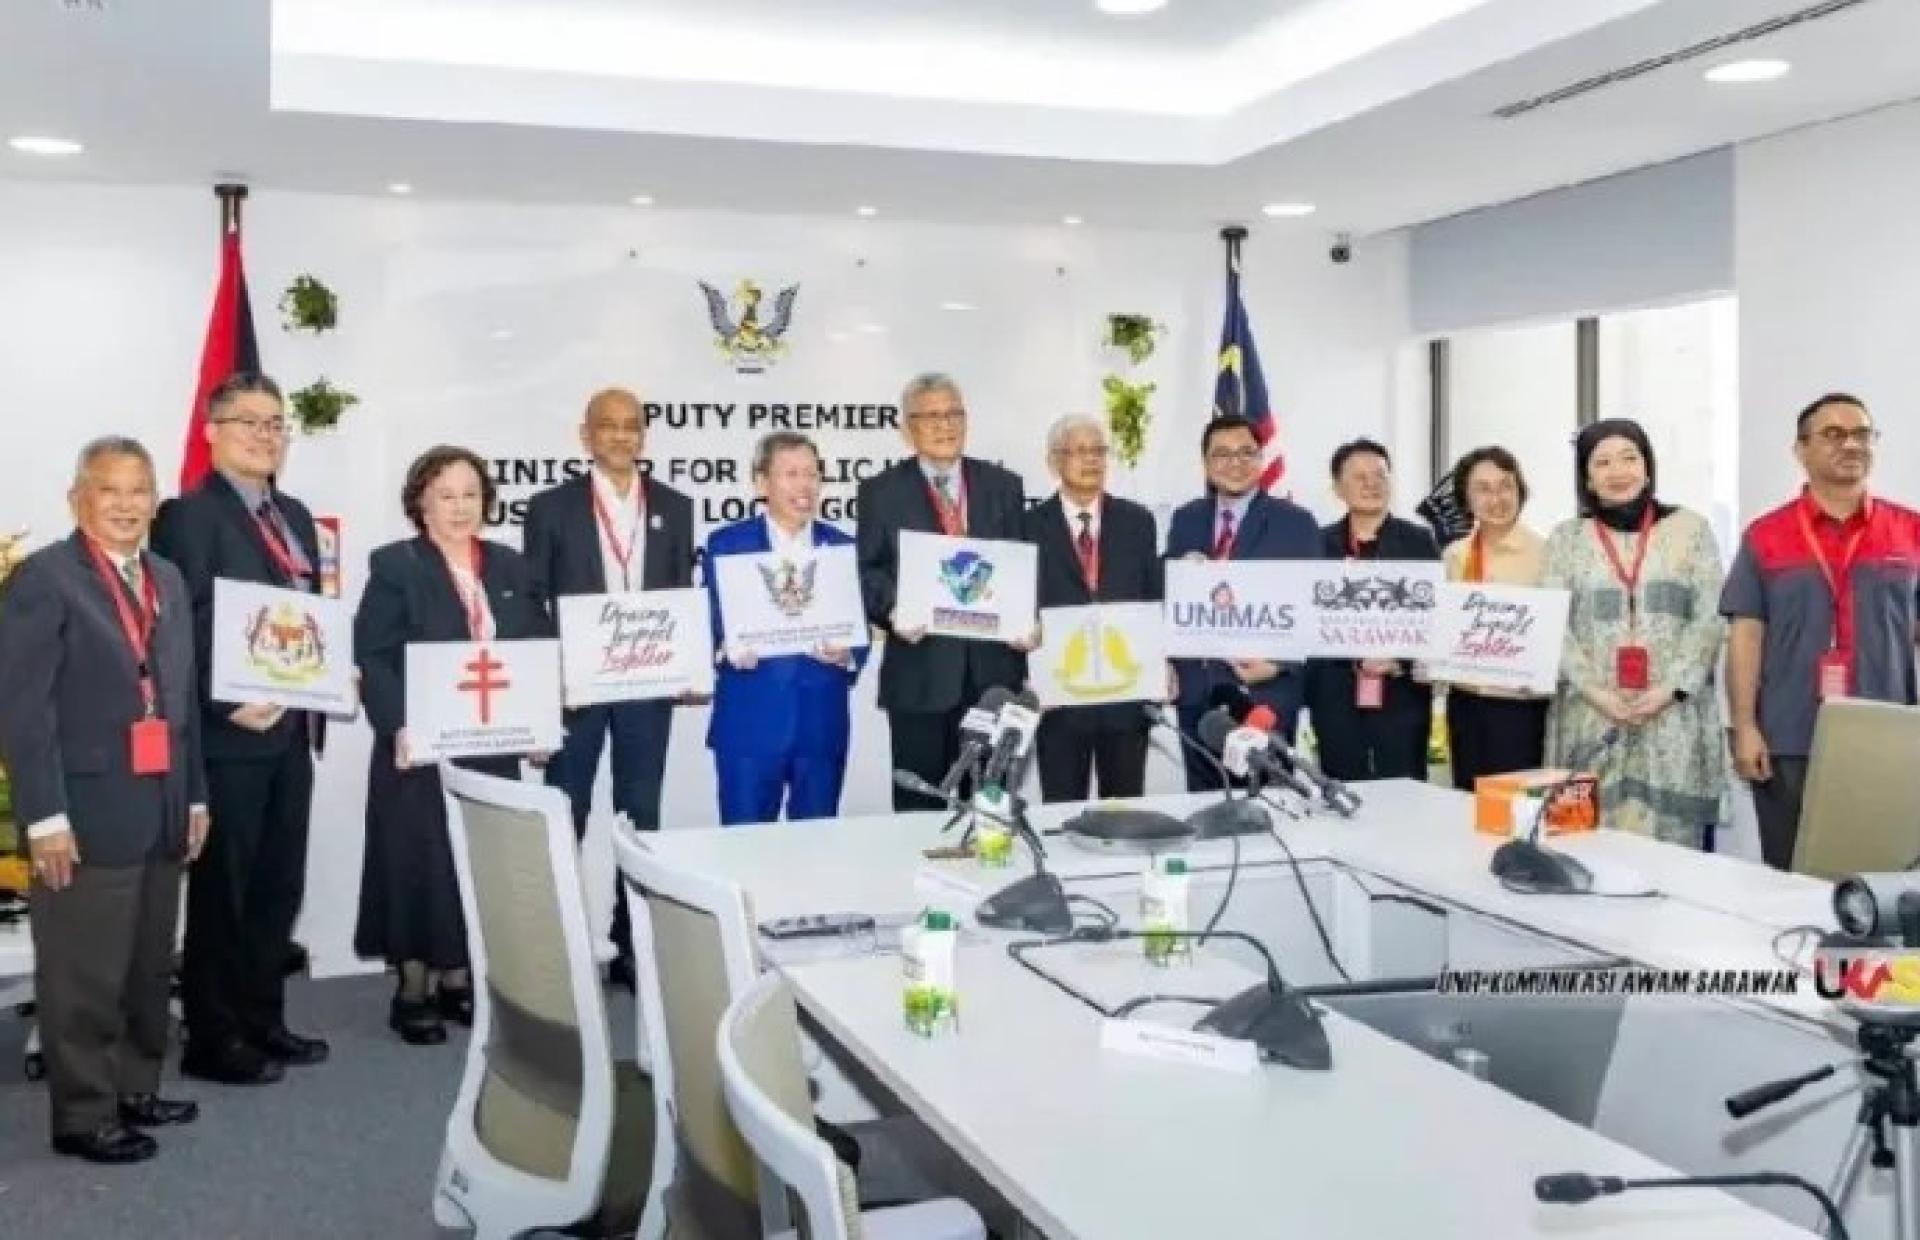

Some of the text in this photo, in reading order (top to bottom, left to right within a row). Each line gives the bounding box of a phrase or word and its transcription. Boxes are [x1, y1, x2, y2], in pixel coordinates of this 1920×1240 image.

[643, 403, 900, 429] PUTY PREMIER
[668, 459, 738, 483] FOR
